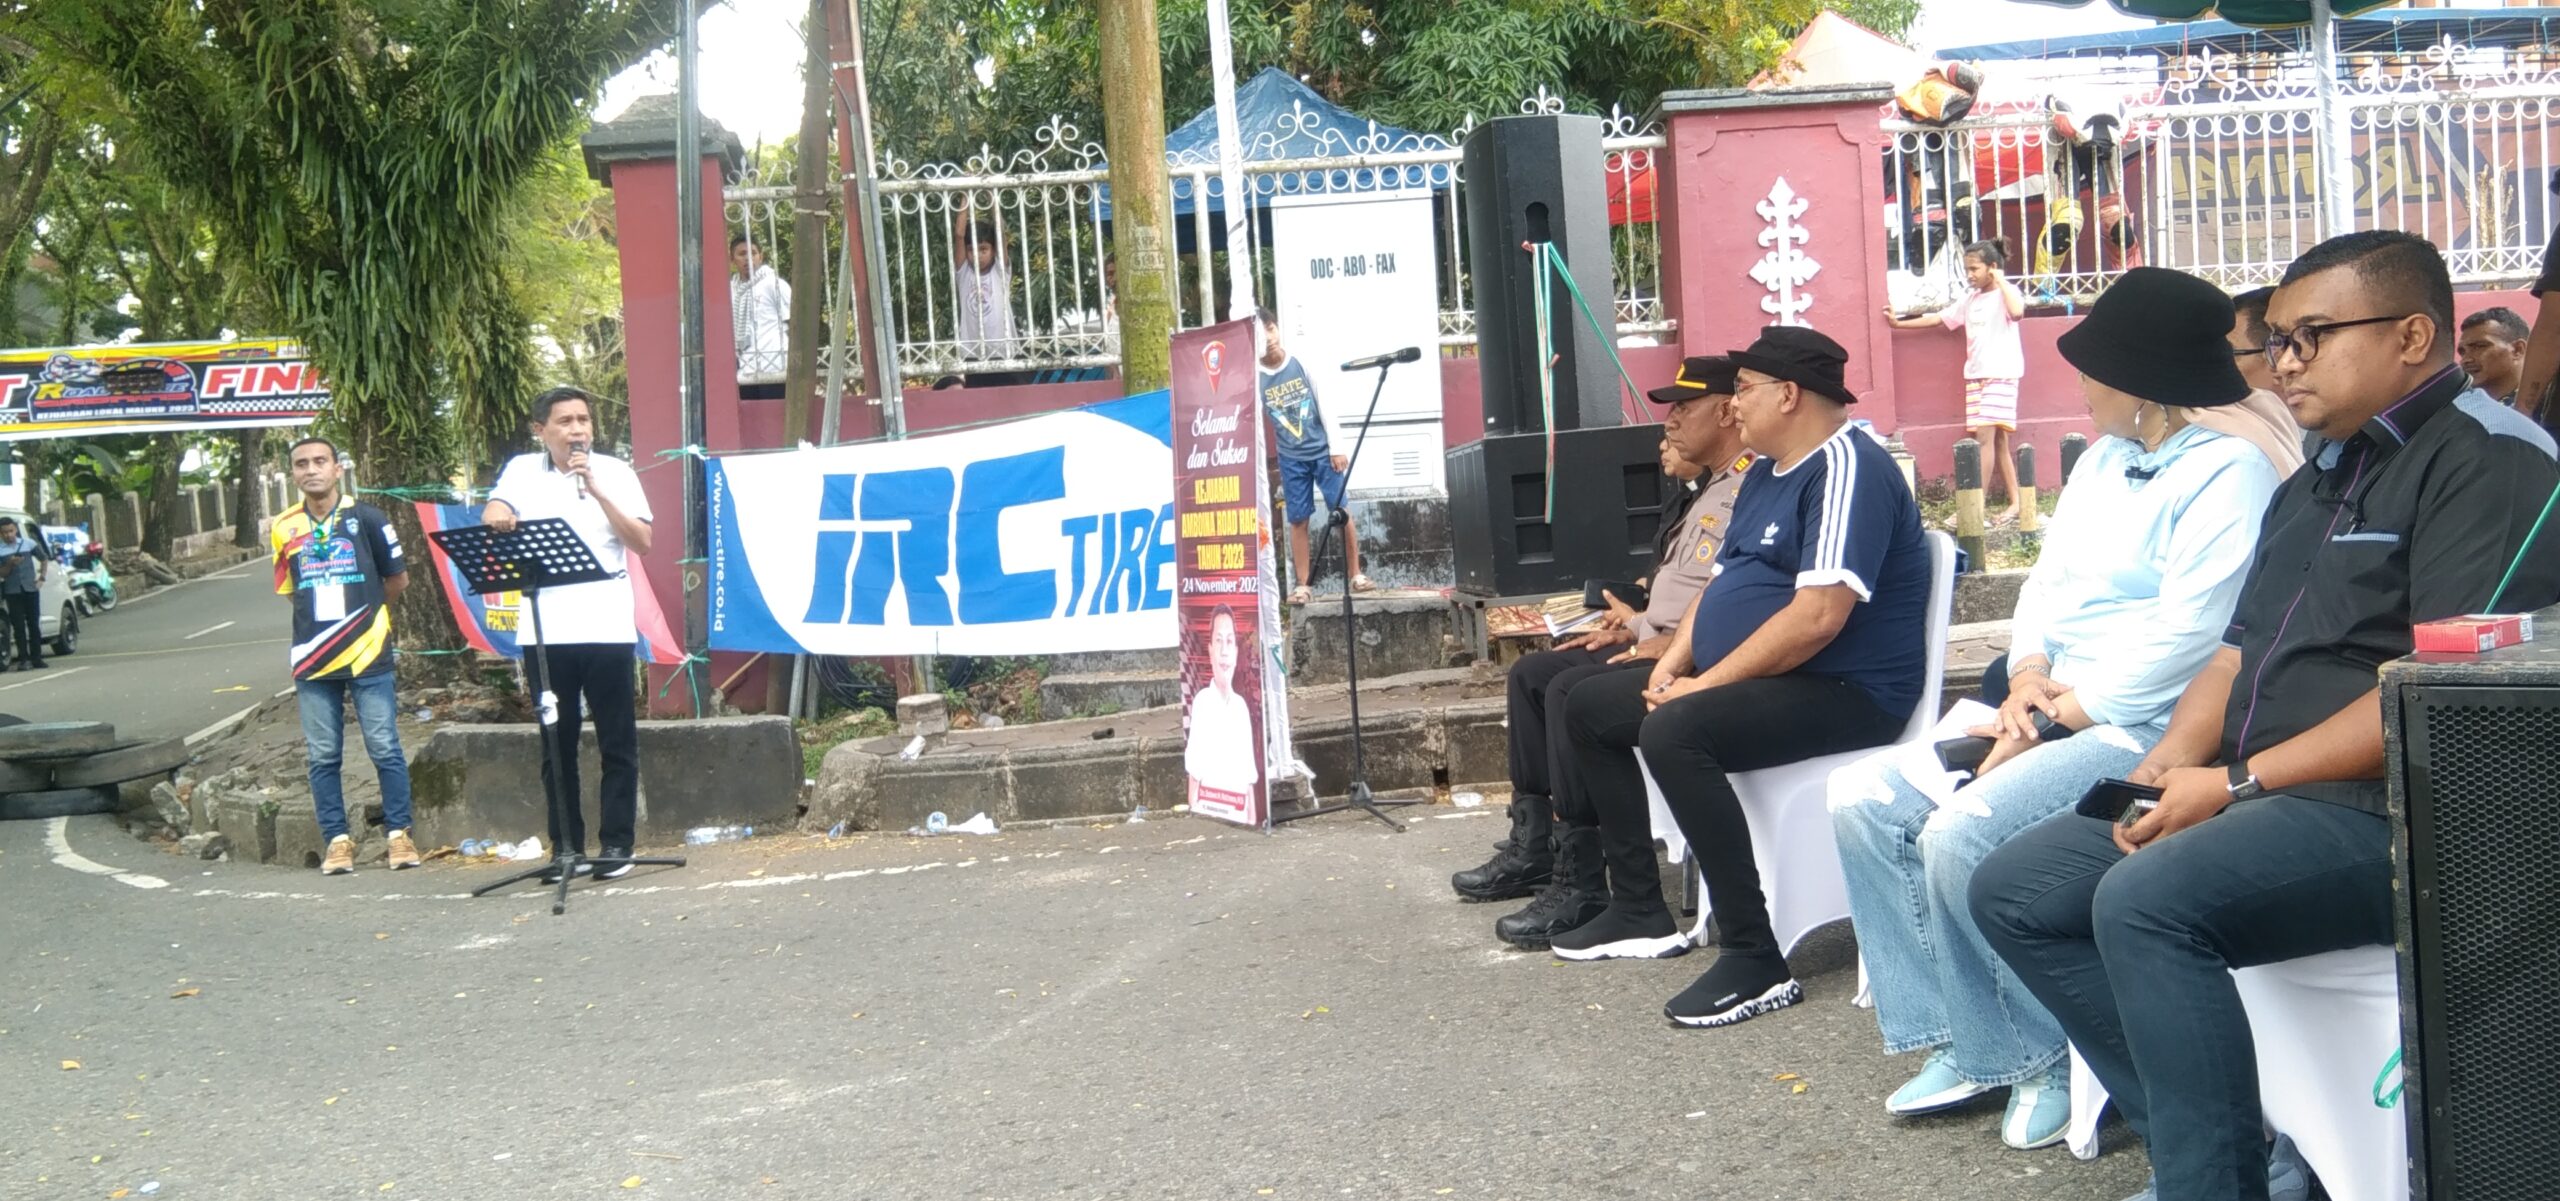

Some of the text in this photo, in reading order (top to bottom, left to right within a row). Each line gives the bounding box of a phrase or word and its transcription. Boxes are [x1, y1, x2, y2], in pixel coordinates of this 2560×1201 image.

[1310, 257, 1334, 280] ODC
[1343, 254, 1367, 277] ABO
[1375, 252, 1396, 274] FAX
[202, 363, 332, 399] FINI
[1264, 377, 1304, 400] SKATE
[95, 408, 123, 416] LOKAL
[125, 406, 165, 415] MALUKU
[1191, 404, 1240, 437] Selamat
[1187, 437, 1248, 470] dan Sukses
[1195, 475, 1240, 505] KEJUARAAN
[1216, 509, 1238, 536] ROAD
[1239, 507, 1257, 535] RAC
[712, 470, 725, 633] www.irctire.co.id
[1061, 501, 1174, 617] TIRE
[1197, 543, 1245, 570] TAHUN 2023
[1183, 577, 1194, 593] 24
[1195, 577, 1238, 593] November
